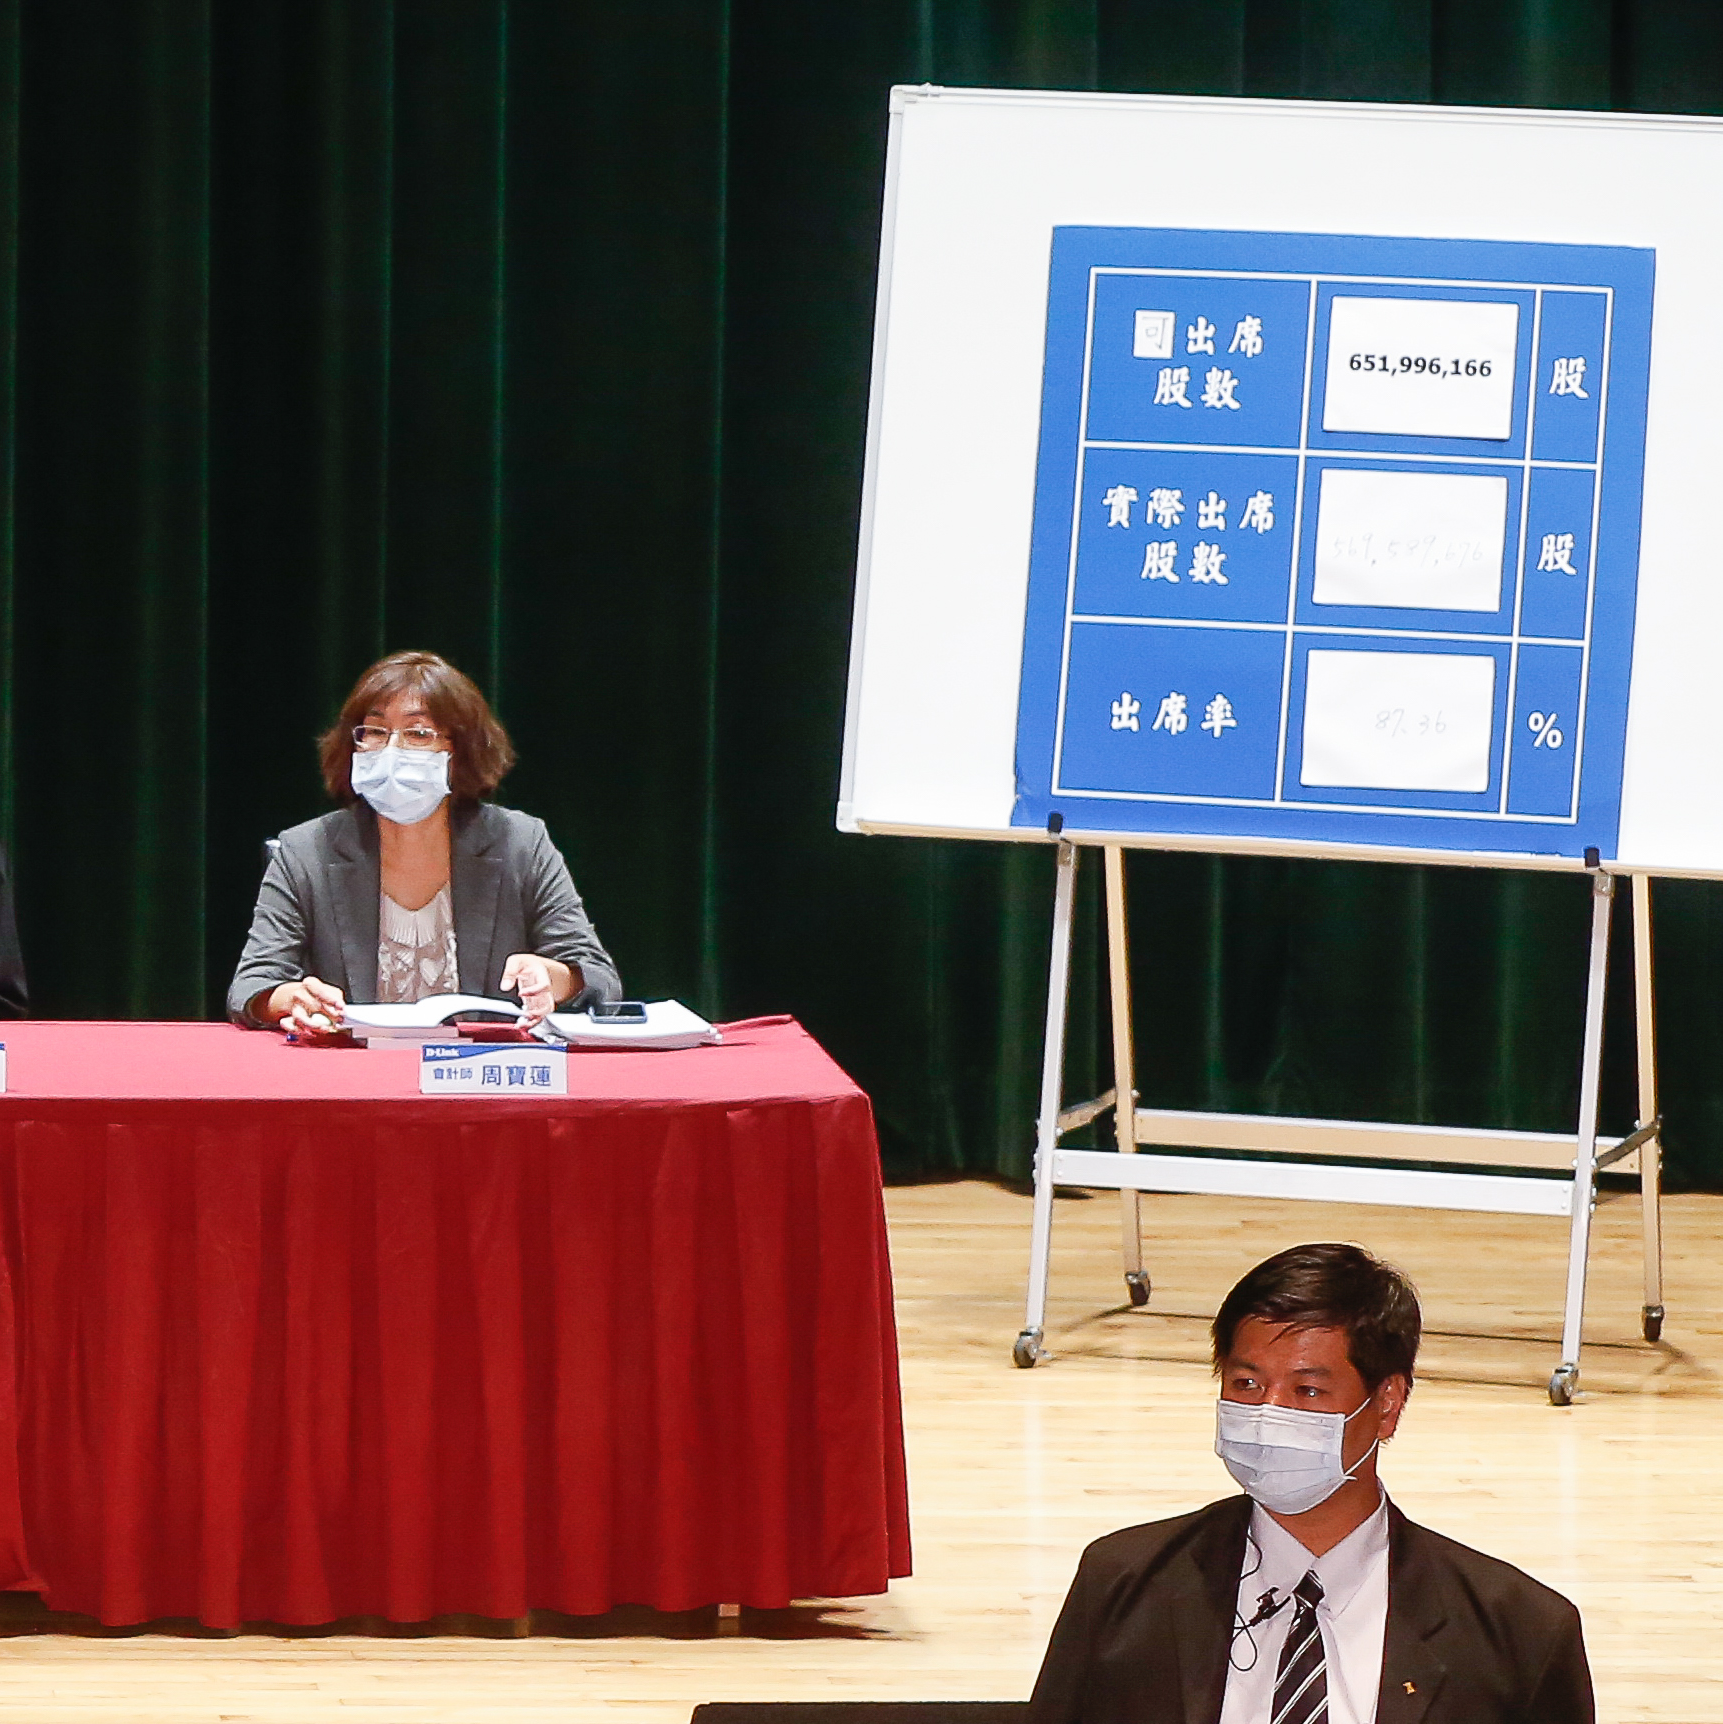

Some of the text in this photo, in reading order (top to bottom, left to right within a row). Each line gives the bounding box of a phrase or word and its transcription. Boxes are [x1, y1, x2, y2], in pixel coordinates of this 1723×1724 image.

[1349, 354, 1492, 379] 651,996,166
[1549, 356, 1589, 399] 股
[1153, 366, 1241, 410] 股數
[1102, 485, 1274, 530] 實際出席
[1141, 541, 1229, 585] 股數
[1537, 533, 1577, 575] 股
[1109, 691, 1237, 738] 出席率
[1528, 712, 1562, 749] %
[425, 1047, 460, 1057] D-Link
[433, 1067, 473, 1080] 會計師
